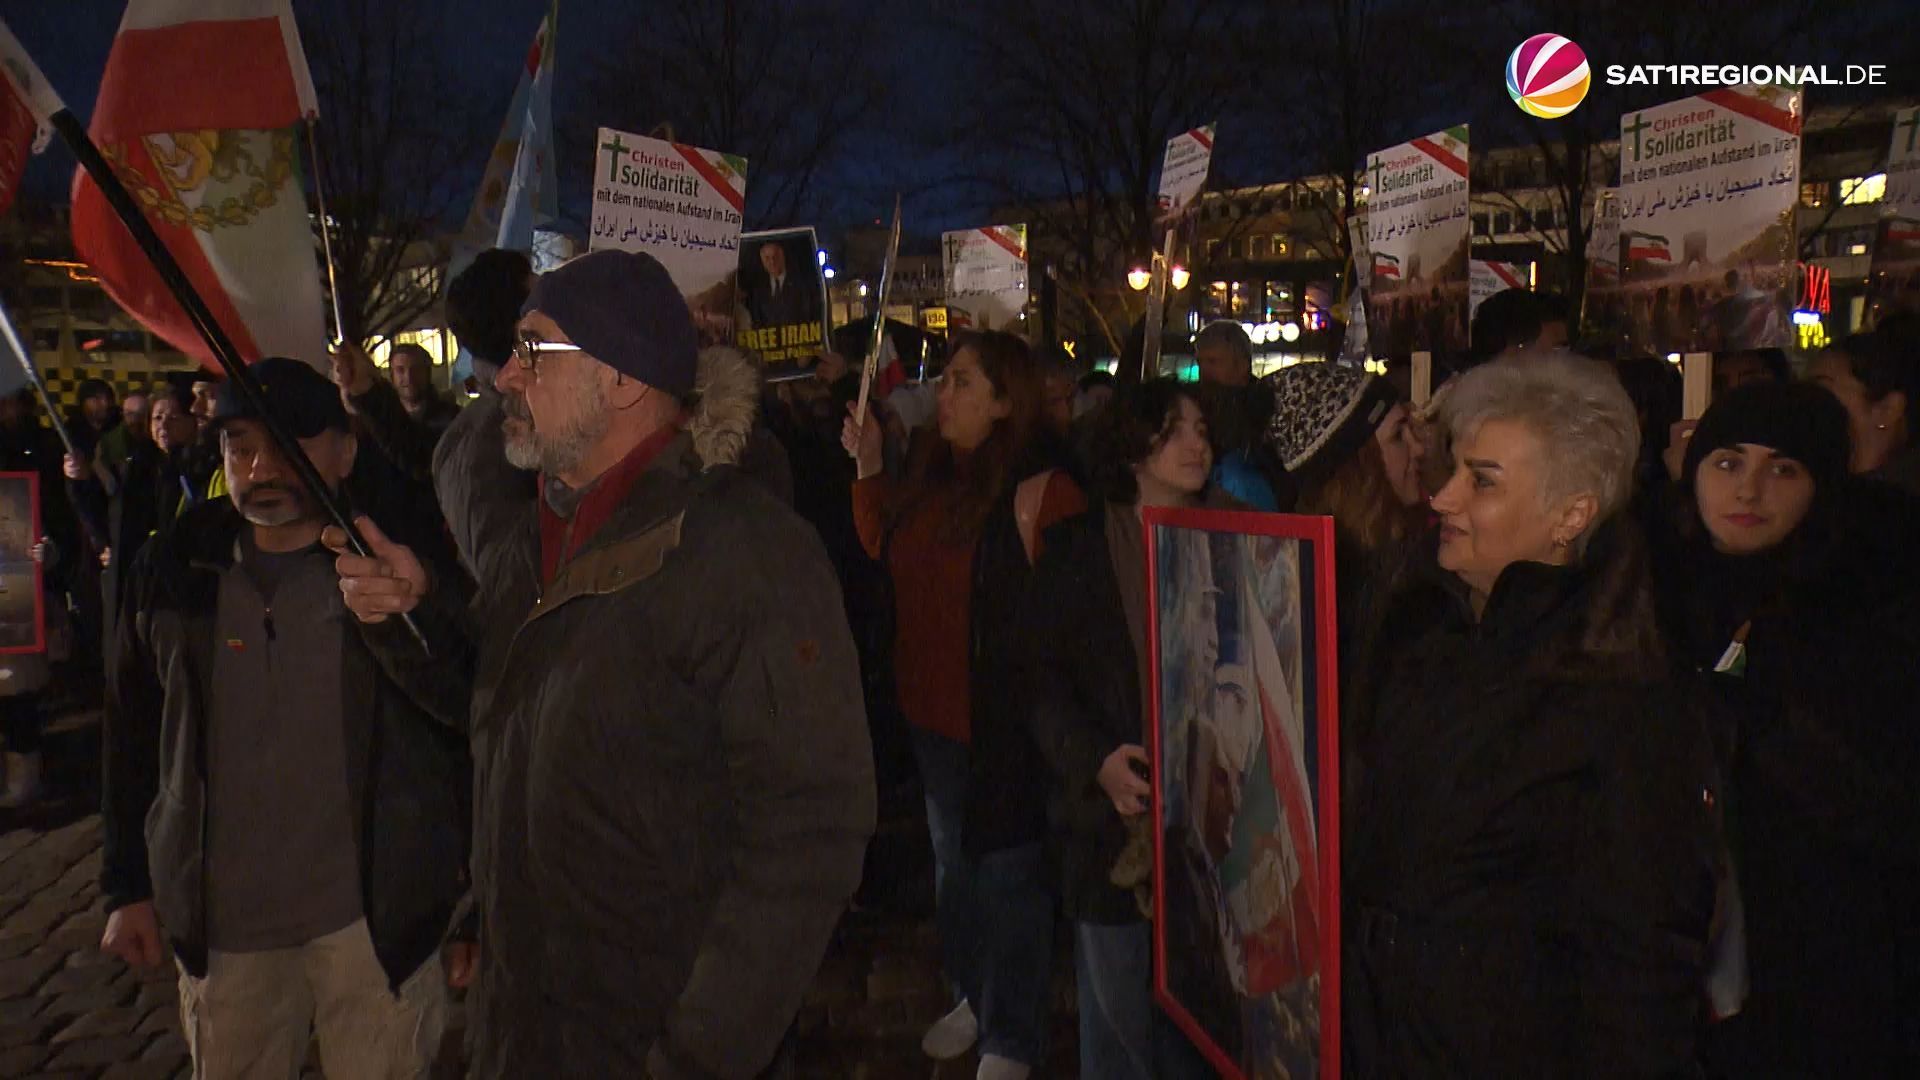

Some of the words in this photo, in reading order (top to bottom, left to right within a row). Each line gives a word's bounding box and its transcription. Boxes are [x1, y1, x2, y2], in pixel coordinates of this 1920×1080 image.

[1654, 109, 1715, 132] Christen
[1645, 119, 1736, 159] Solidarität
[632, 151, 684, 171] Christen
[1638, 167, 1657, 182] dem
[1659, 157, 1706, 177] nationalen
[1711, 143, 1754, 167] Aufstand
[1774, 137, 1797, 154] Iran
[621, 165, 700, 198] Solidarität
[1382, 164, 1433, 193] Solidarität
[597, 188, 610, 202] mit
[613, 190, 631, 206] dem
[633, 195, 675, 213] nationalen
[677, 201, 712, 220] Aufstand
[713, 206, 723, 221] im
[725, 209, 741, 224] Iran
[781, 320, 821, 346] IRAN
